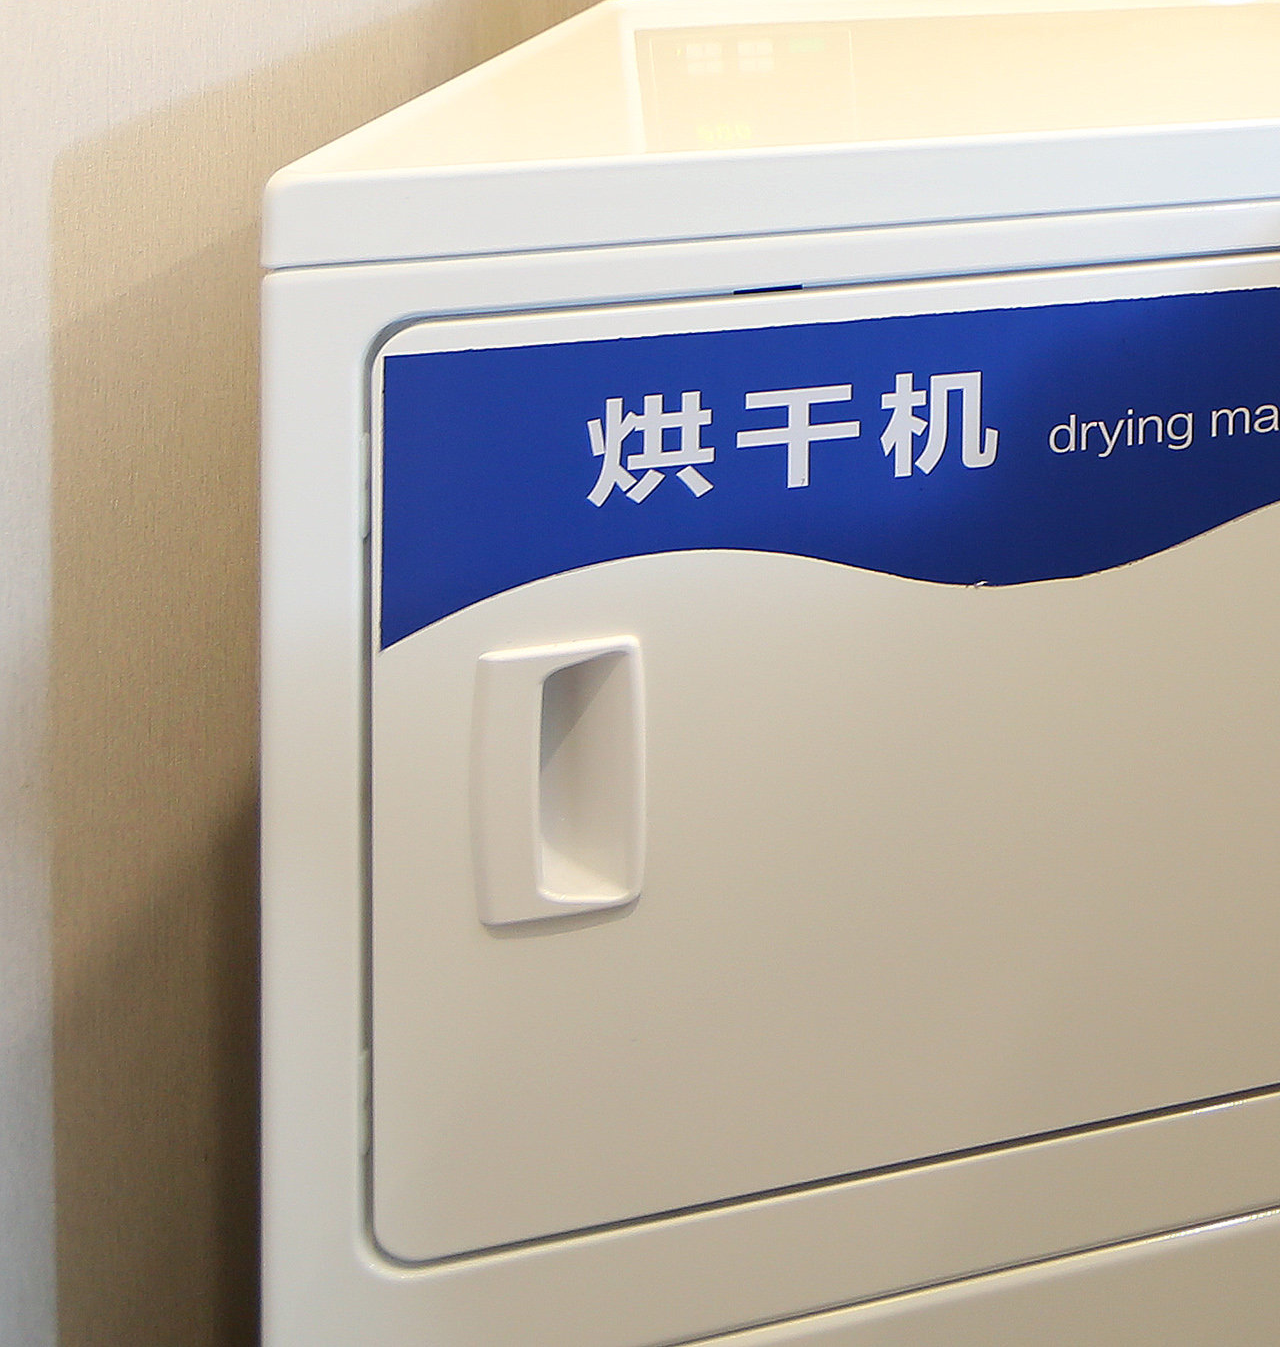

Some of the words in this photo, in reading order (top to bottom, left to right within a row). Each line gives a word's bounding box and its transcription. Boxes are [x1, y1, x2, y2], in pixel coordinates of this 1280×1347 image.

[586, 370, 1000, 507] 烘干机
[1048, 408, 1194, 458] drying
